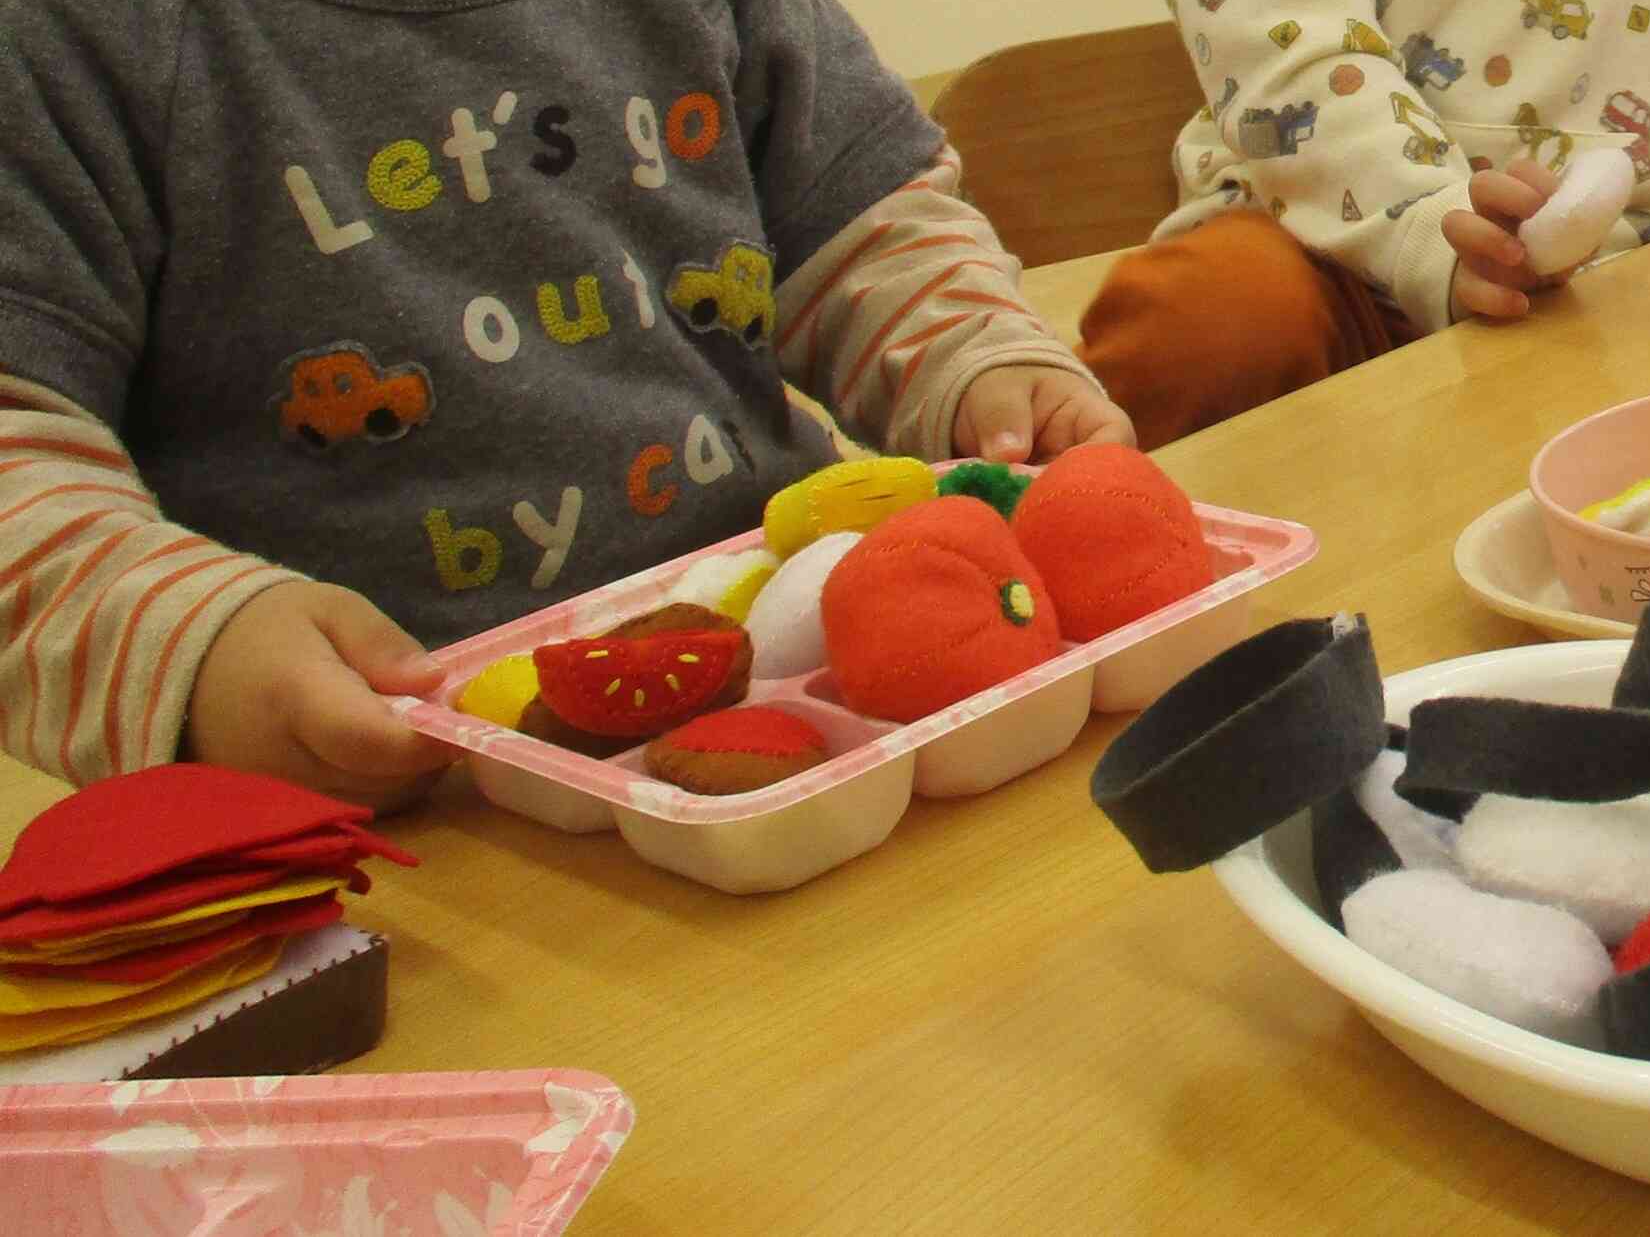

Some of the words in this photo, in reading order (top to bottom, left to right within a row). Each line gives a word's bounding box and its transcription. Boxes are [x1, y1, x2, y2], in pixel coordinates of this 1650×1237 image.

[285, 90, 577, 255] Let's
[625, 92, 720, 189] go
[424, 485, 583, 590] by
